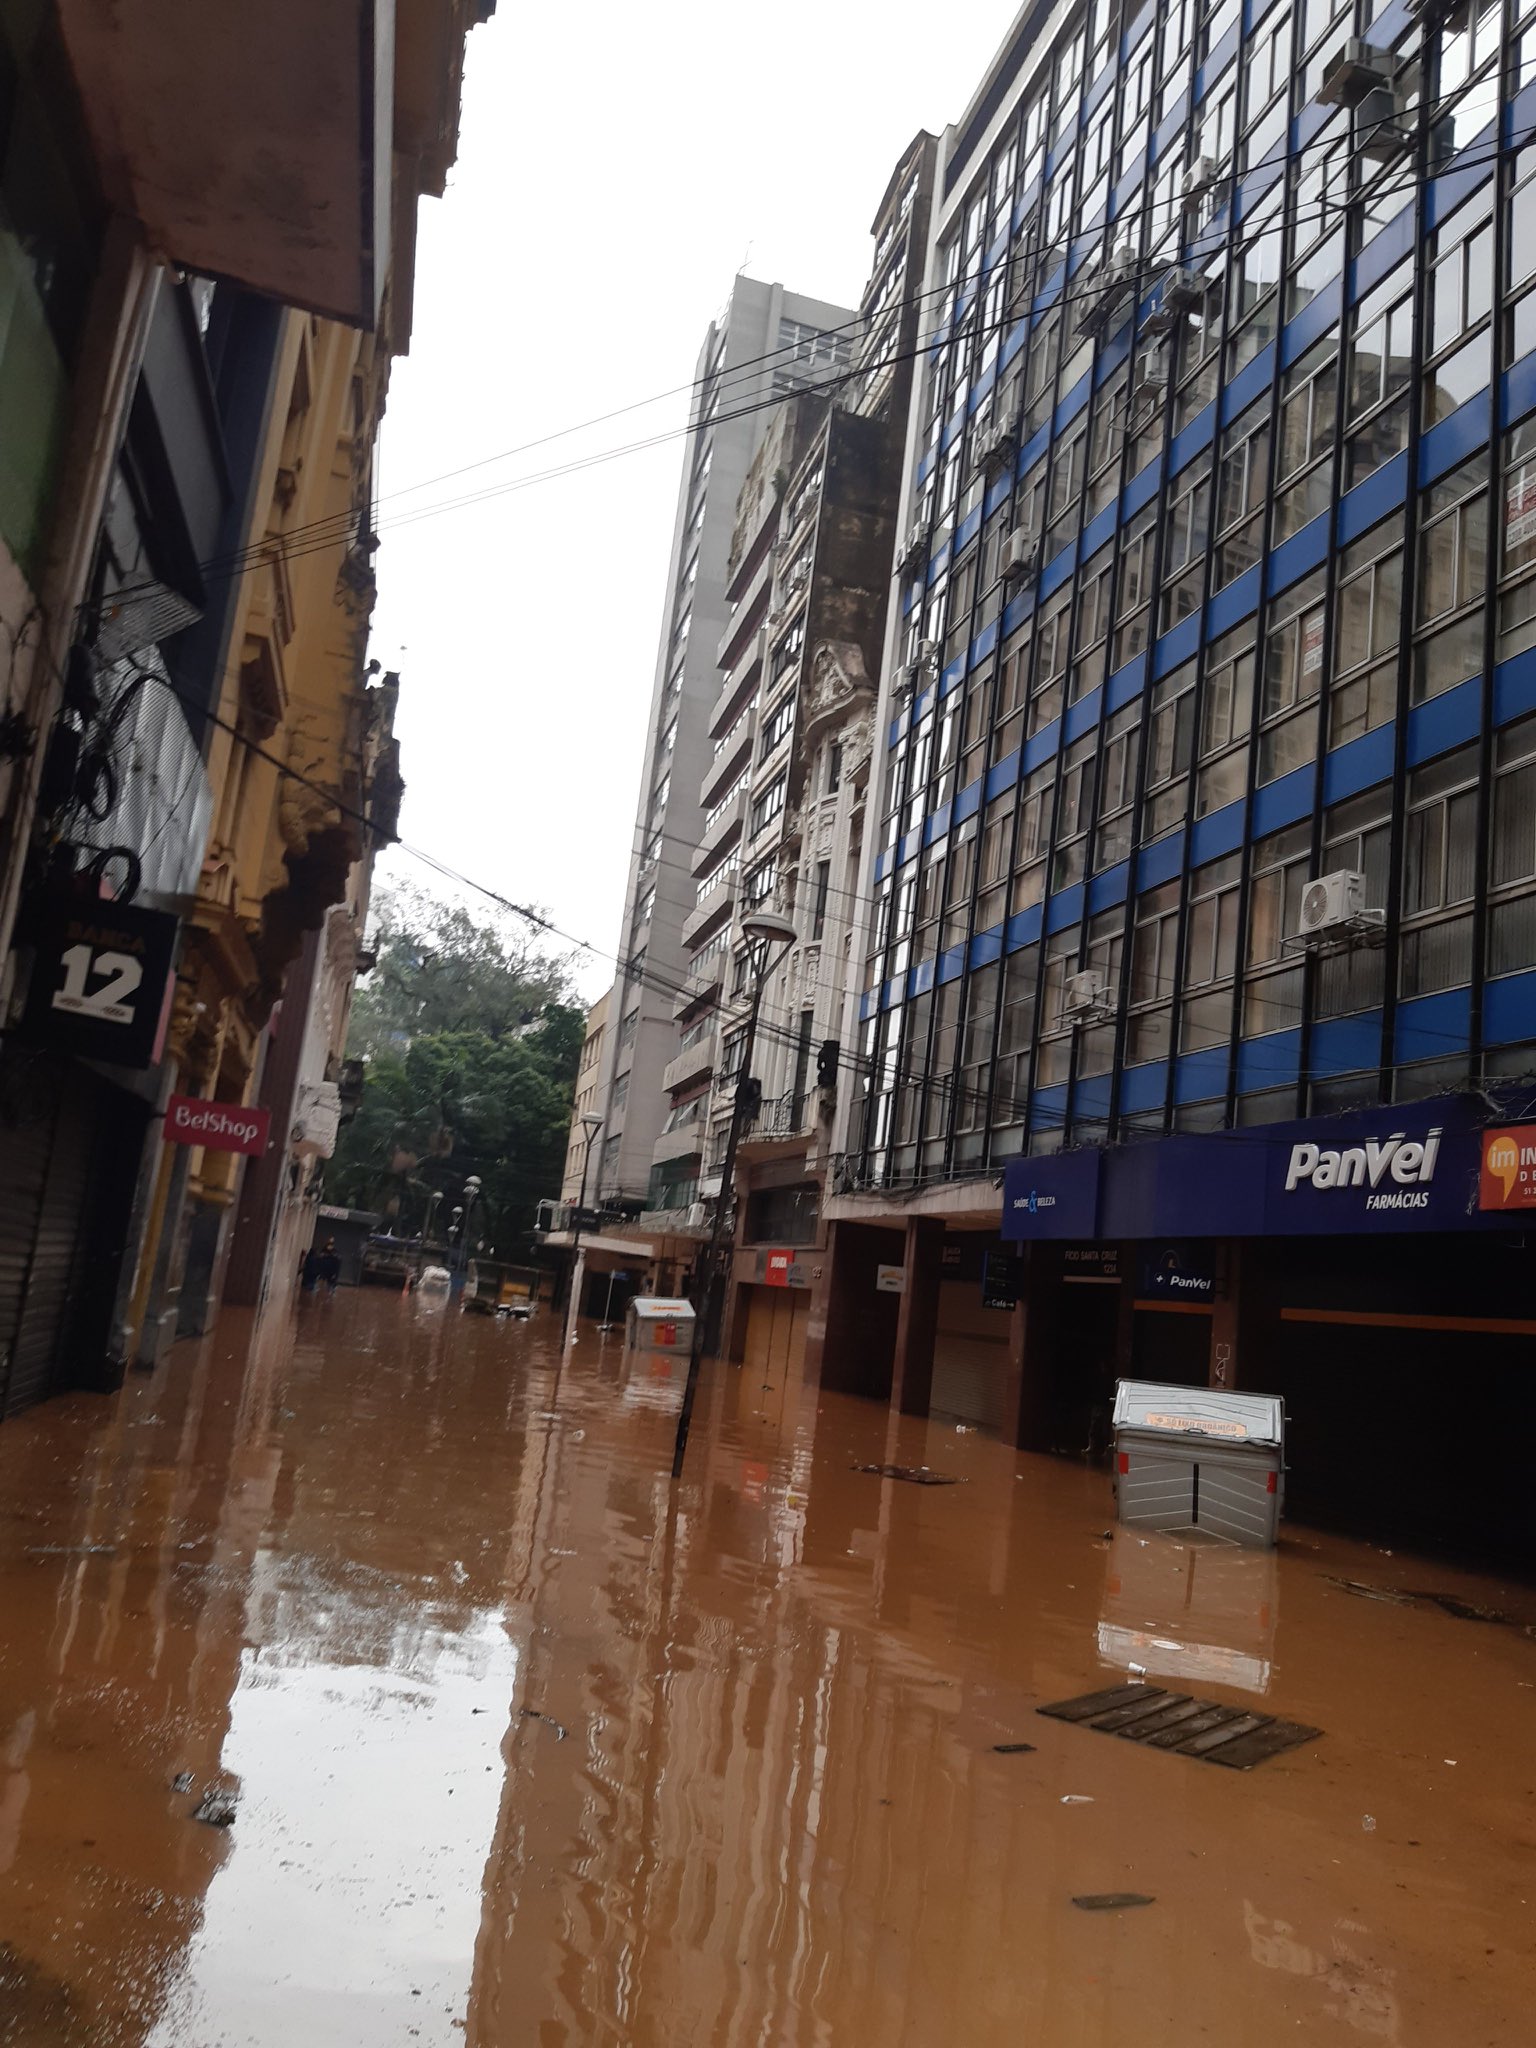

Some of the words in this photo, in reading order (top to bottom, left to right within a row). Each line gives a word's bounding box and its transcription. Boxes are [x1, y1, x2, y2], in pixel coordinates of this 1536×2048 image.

[52, 944, 144, 1024] 12
[175, 1105, 259, 1144] BelShop
[1037, 1196, 1055, 1207] BELEZA
[1366, 1190, 1430, 1210] FARMÁCIAS
